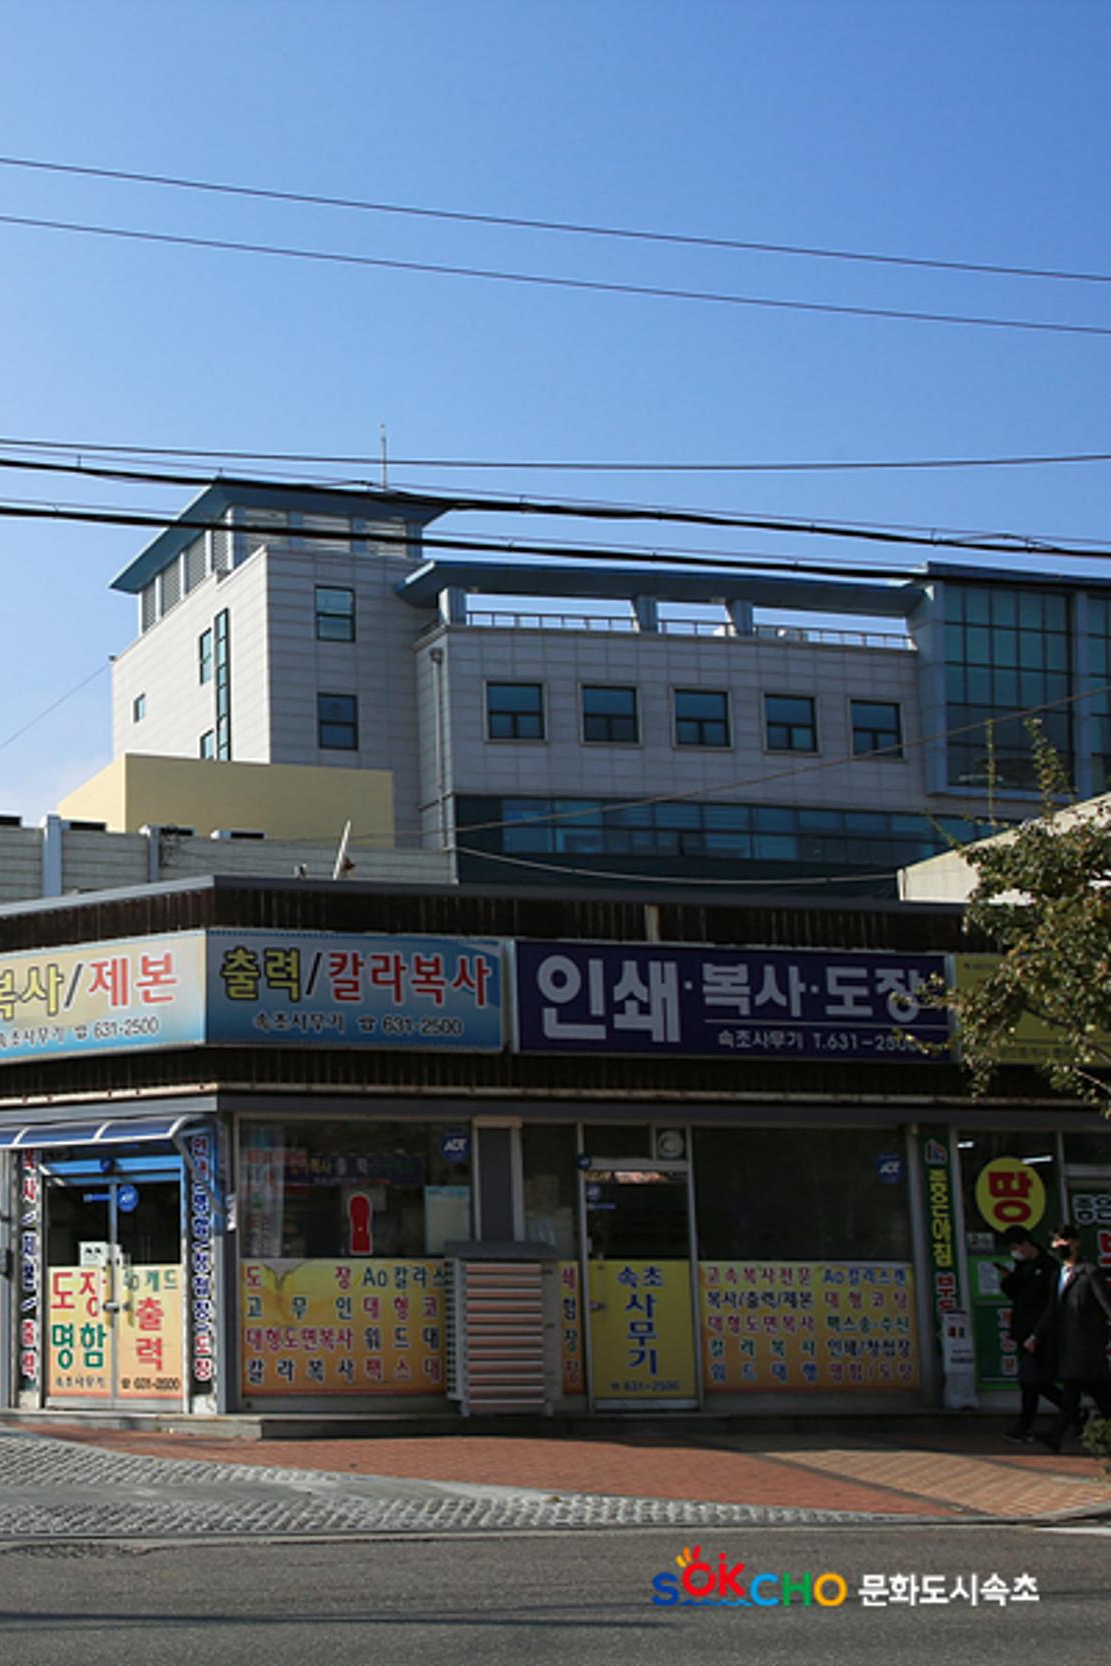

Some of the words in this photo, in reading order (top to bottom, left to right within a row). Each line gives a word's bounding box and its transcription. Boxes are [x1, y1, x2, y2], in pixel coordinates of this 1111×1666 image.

[221, 946, 490, 1006] 출력/칼라복사
[382, 1017, 463, 1036] 631-2500
[718, 1030, 804, 1050] 속초사무기
[618, 1267, 664, 1288] 속초
[52, 1323, 107, 1370] 명함
